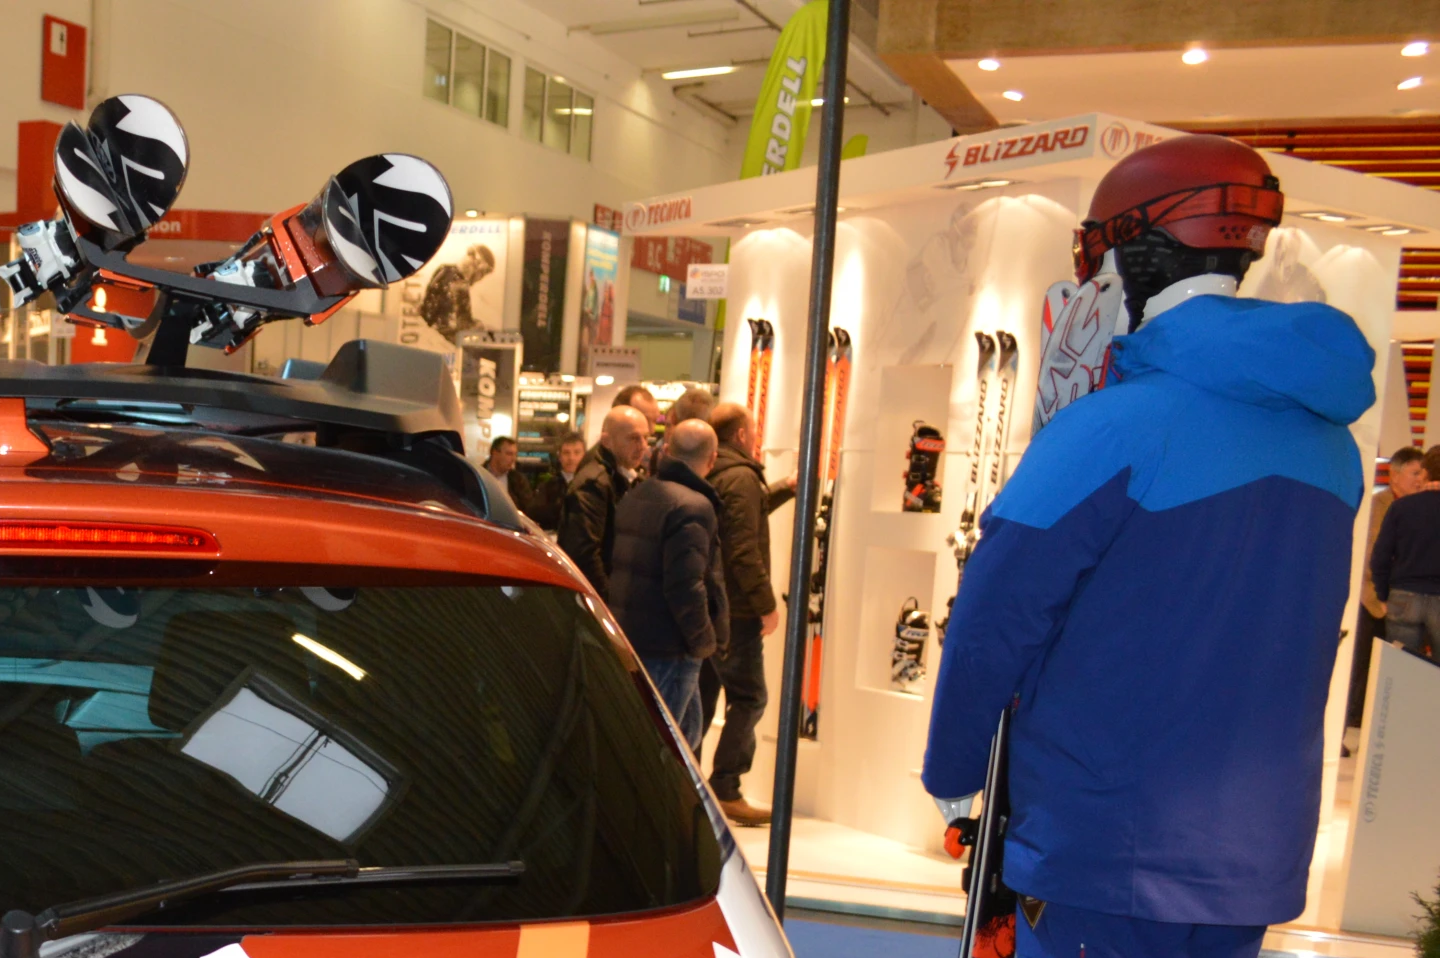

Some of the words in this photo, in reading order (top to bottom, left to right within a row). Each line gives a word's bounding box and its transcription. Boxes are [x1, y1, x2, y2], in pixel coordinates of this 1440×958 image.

[648, 197, 692, 225] TECNICA
[970, 378, 988, 484] BLIZZARD
[990, 378, 1008, 484] BLIZZARD
